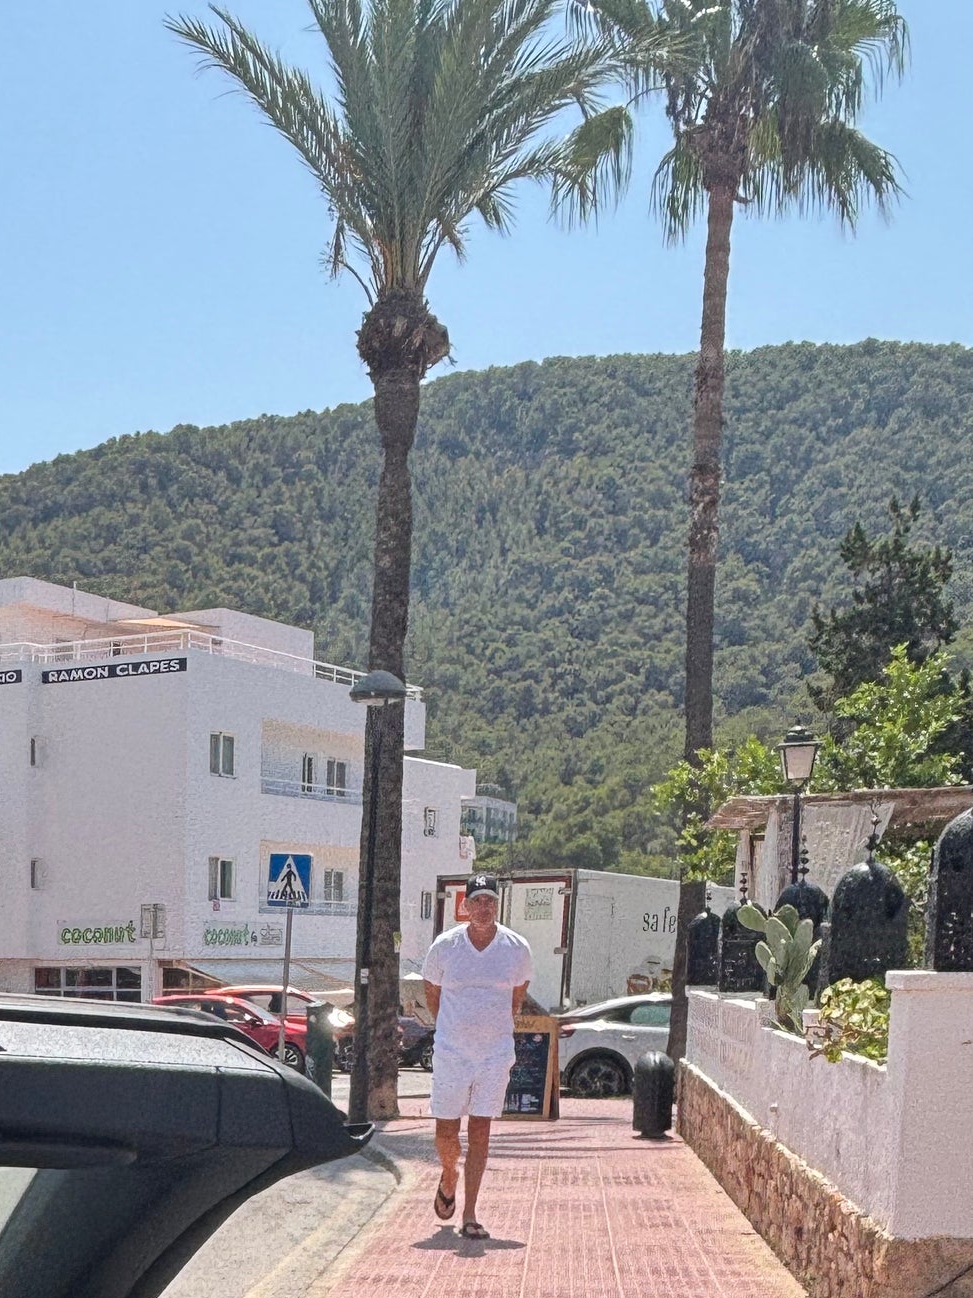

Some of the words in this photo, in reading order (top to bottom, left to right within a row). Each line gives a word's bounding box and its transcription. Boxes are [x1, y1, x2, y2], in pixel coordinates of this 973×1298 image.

[48, 666, 110, 683] RAMON
[116, 660, 180, 676] CLAPES
[60, 920, 137, 944] coconut
